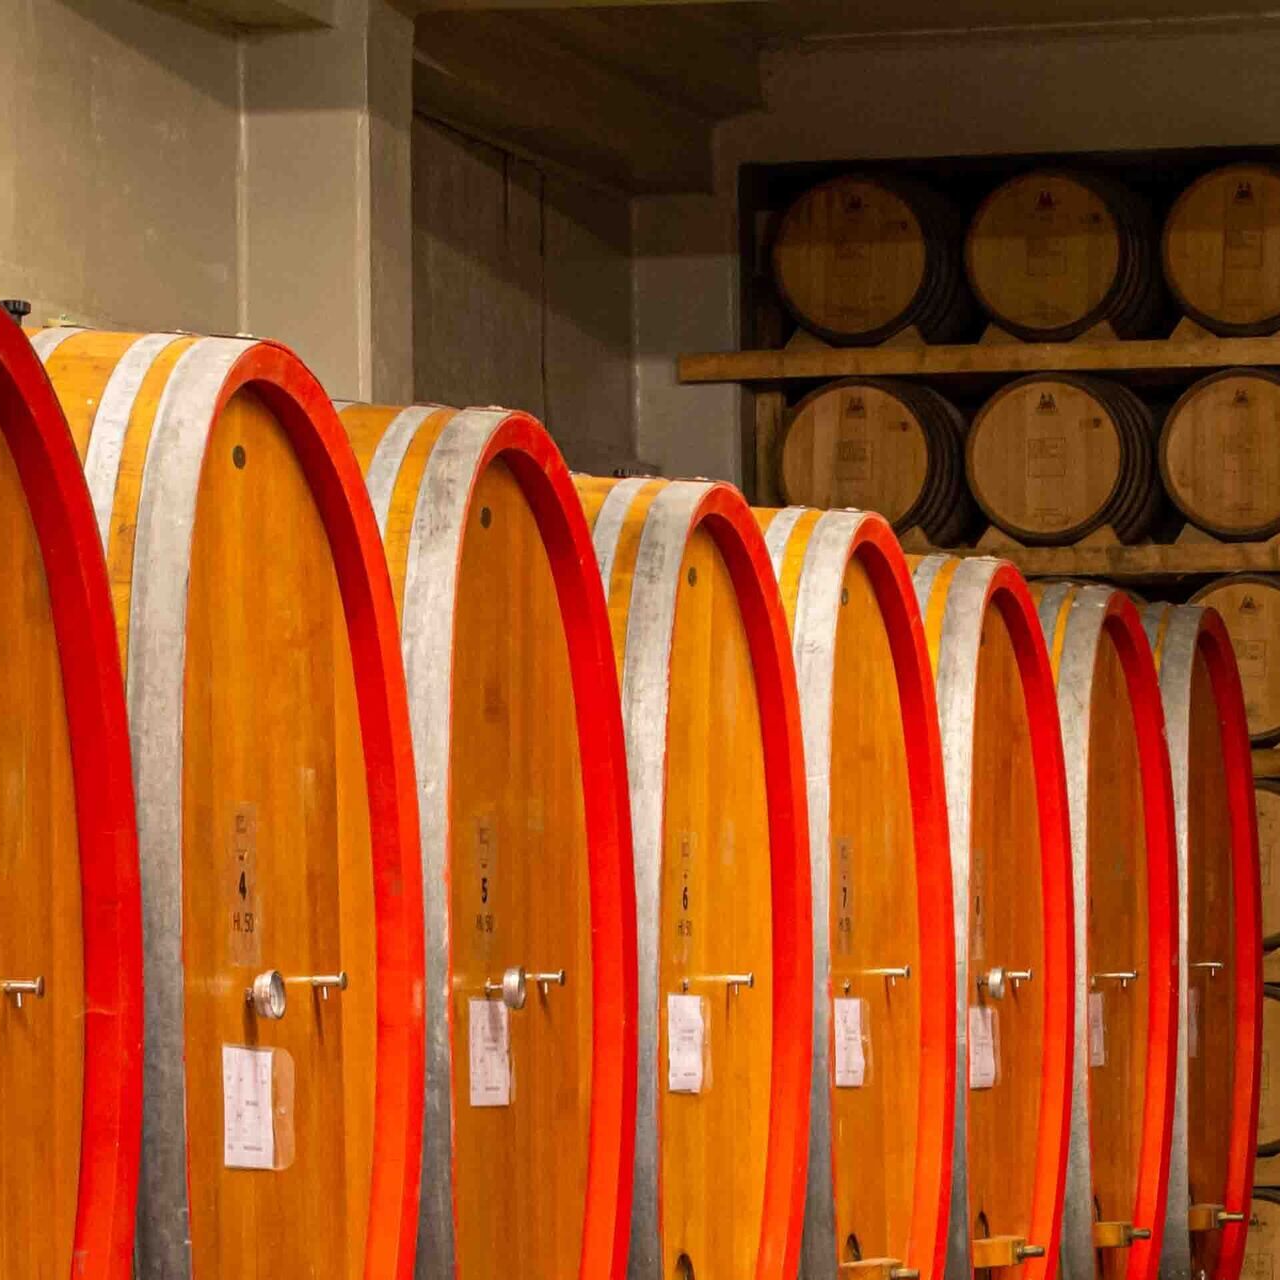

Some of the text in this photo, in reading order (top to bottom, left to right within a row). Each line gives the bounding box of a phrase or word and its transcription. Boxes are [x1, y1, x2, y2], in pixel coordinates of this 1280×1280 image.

[239, 871, 247, 901] 4
[481, 877, 488, 904] 5
[682, 886, 689, 911] 6
